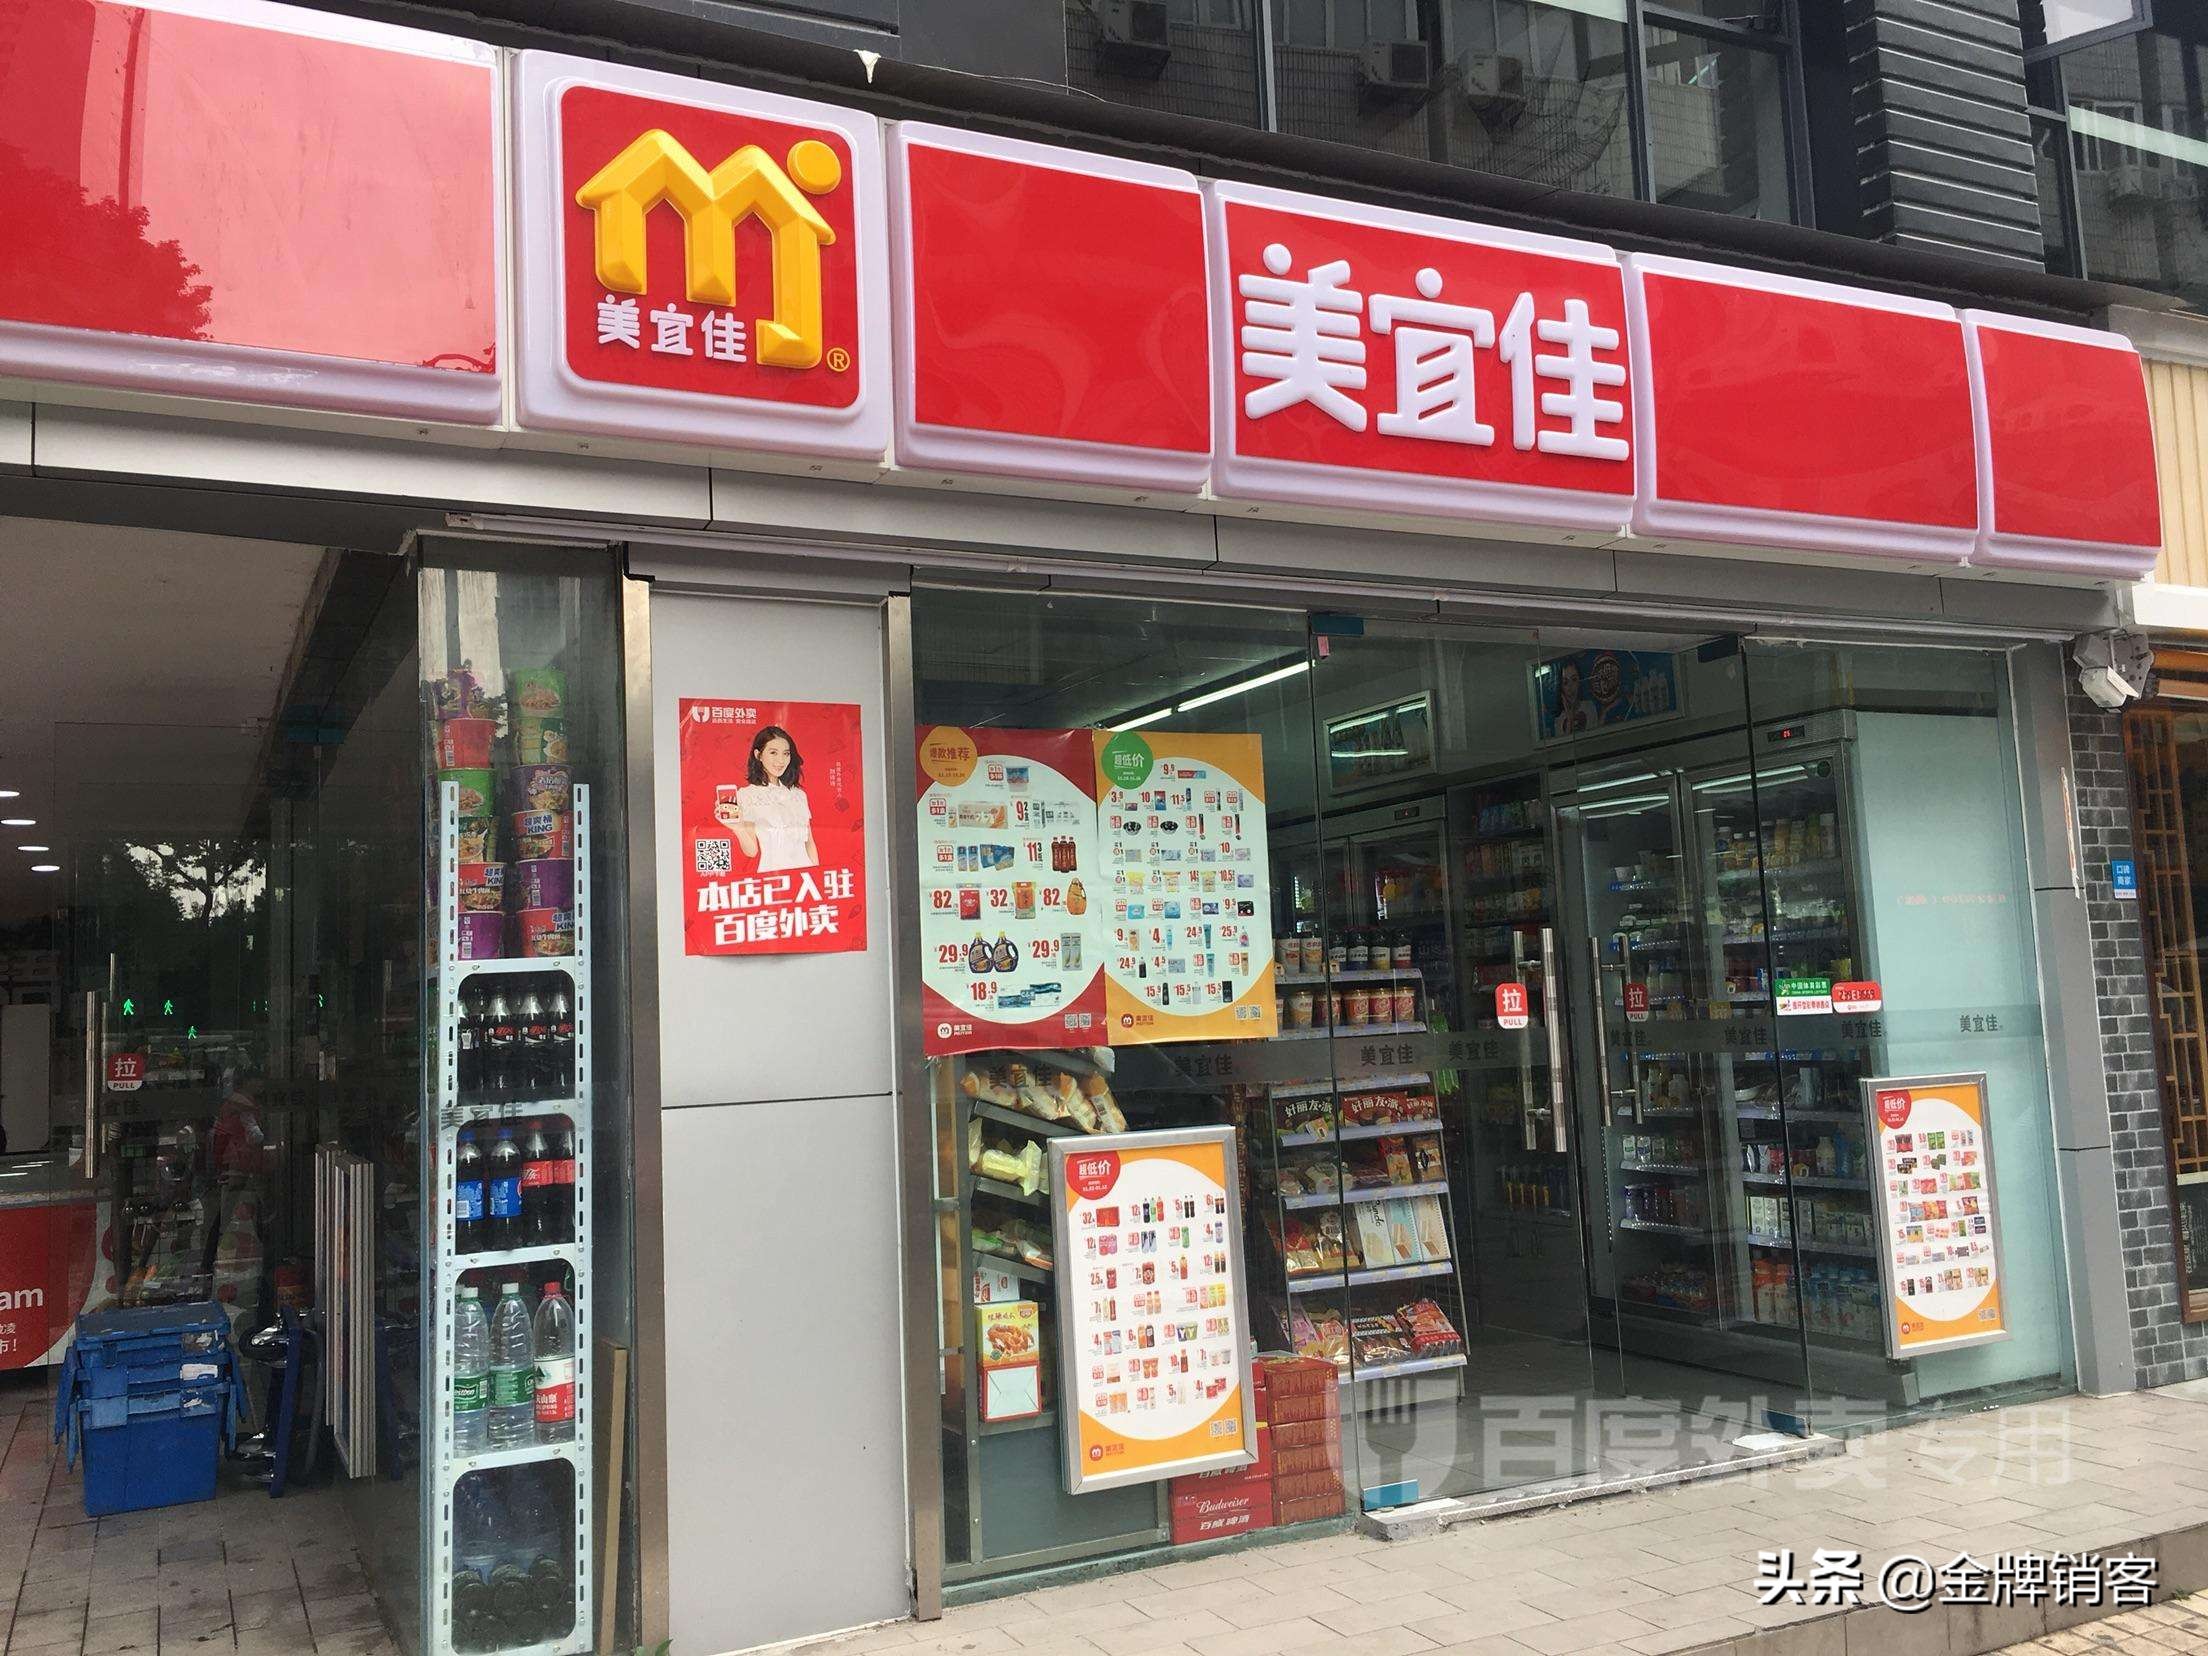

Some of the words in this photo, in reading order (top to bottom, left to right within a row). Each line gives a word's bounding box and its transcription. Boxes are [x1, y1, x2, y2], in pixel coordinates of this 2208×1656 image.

[597, 294, 747, 364] 美宜佳
[1238, 243, 1630, 462] 美宜佳
[712, 707, 757, 719] 百度外卖
[528, 824, 552, 833] KING
[487, 877, 503, 885] KIN
[697, 868, 855, 912] 本店已入驻
[556, 922, 574, 931] KIN
[713, 904, 839, 945] 百度外卖
[1791, 981, 1827, 989] 中国体育彩票
[1502, 988, 1523, 1012] 拉
[1628, 987, 1645, 1008] 拉
[1503, 1018, 1523, 1027] PULL
[1841, 1019, 1882, 1038] 美宜佳
[1960, 1014, 1999, 1033] 美宜佳
[1361, 1043, 1414, 1067] 美宜佳
[1449, 1039, 1499, 1061] 美宜佳
[115, 1057, 137, 1077] 拉
[1284, 1099, 1333, 1118] 好丽友·派
[1351, 1095, 1400, 1114] 好丽友·派
[1196, 1497, 1249, 1513] Budweiser
[1200, 1515, 1250, 1531] 百威啤酒
